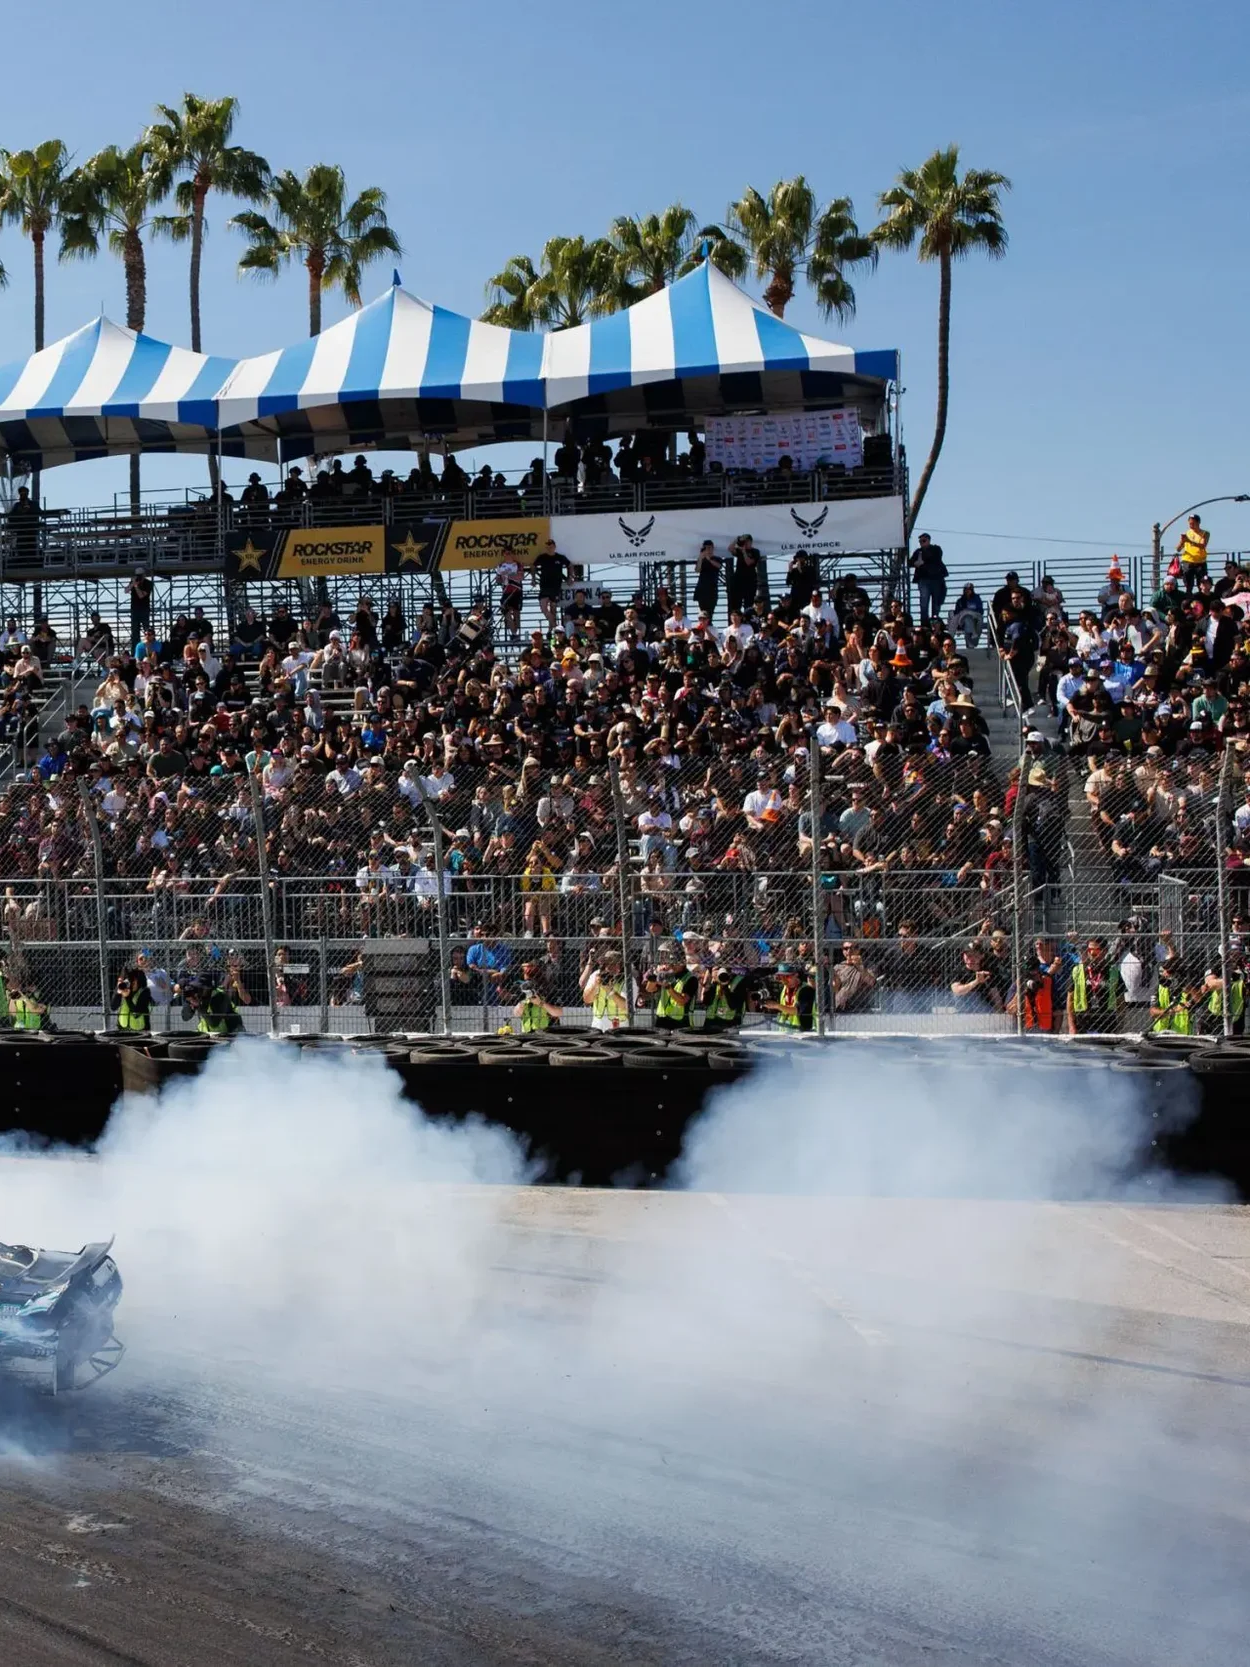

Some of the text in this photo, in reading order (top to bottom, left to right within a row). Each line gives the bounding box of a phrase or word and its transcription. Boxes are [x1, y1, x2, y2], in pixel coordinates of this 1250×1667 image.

[455, 532, 538, 549] ROCKSTAR
[293, 541, 373, 557] ROCKSTAR
[463, 549, 499, 558] ENERGY
[301, 555, 364, 566] ENERGY DRINK
